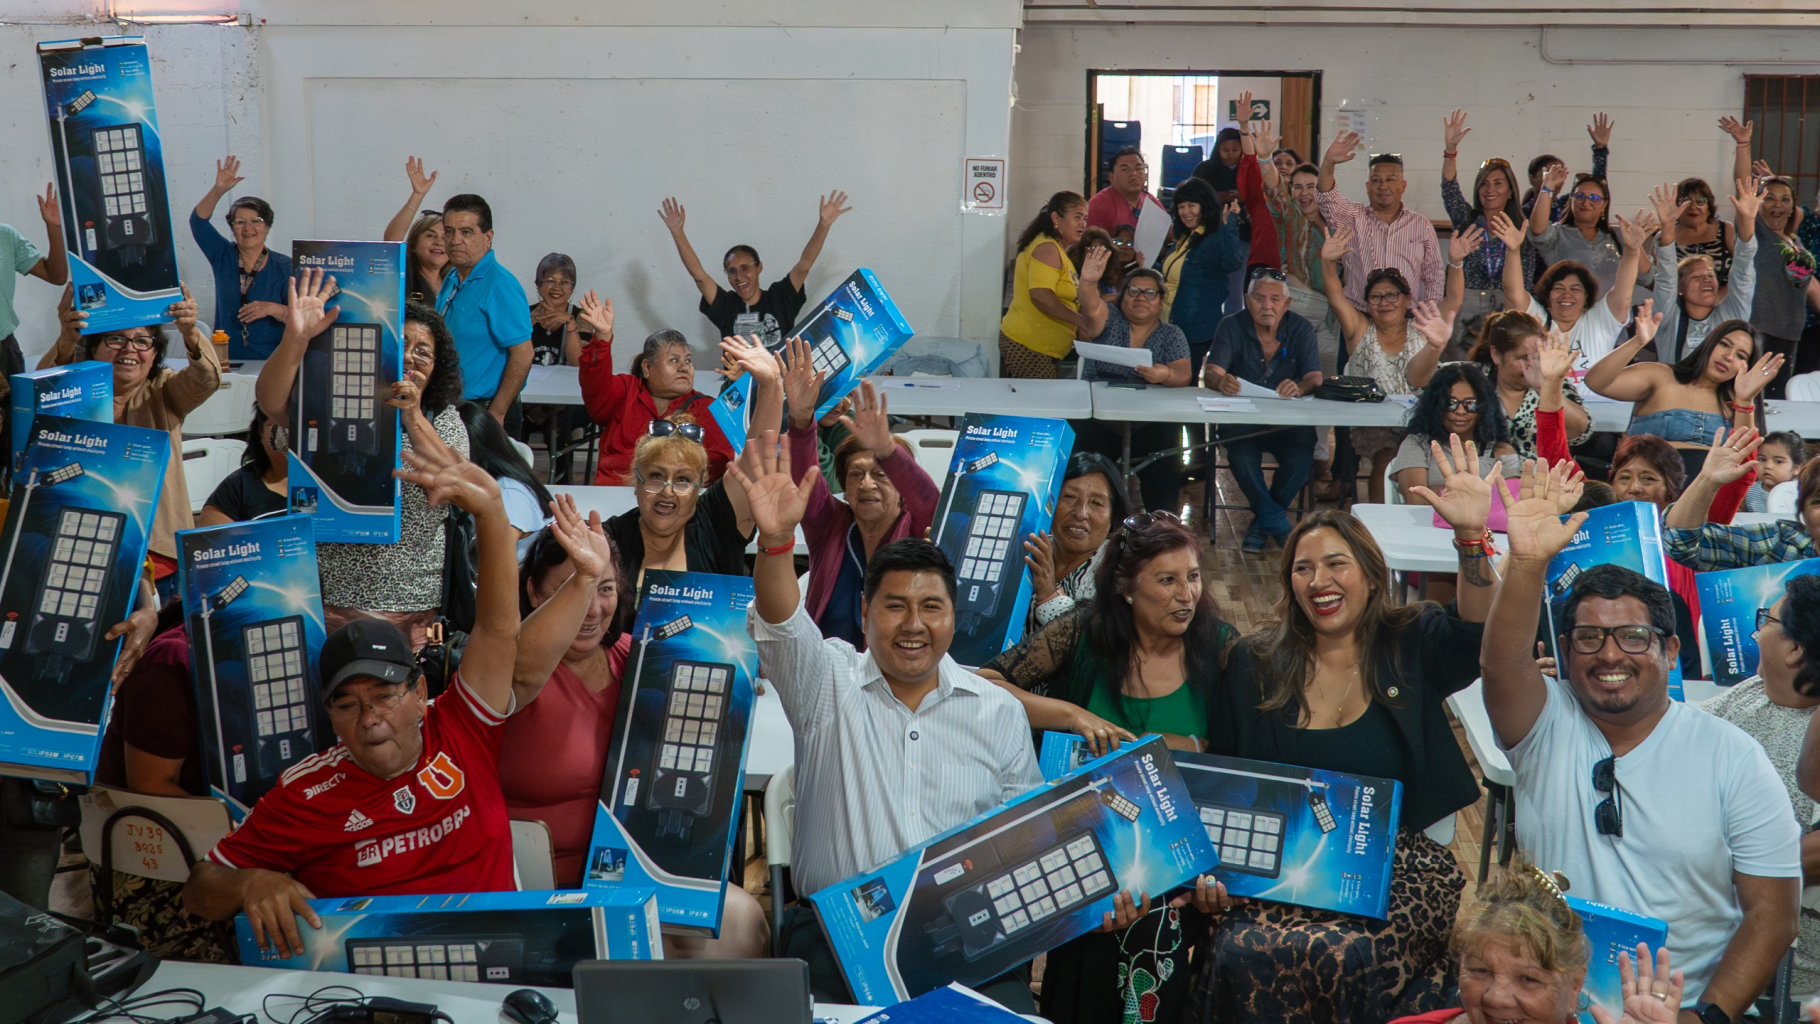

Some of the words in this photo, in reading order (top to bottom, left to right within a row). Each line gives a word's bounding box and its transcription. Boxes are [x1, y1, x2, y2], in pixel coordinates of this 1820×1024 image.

[50, 67, 76, 77] Solar
[78, 64, 105, 75] Light
[300, 255, 325, 264] Solar
[328, 256, 354, 267] Light
[849, 281, 862, 299] Solar
[860, 298, 875, 317] Light
[40, 391, 61, 402] Solar
[62, 386, 82, 398] Light
[39, 429, 72, 442] Solar
[74, 434, 108, 448] Light
[966, 425, 991, 436] Solar
[993, 427, 1017, 438] Light
[1570, 530, 1590, 544] ght
[193, 548, 226, 561] Solar
[228, 542, 261, 556] Light
[650, 584, 680, 596] Solar
[682, 587, 713, 600] Light
[1721, 618, 1733, 646] Light
[1727, 648, 1738, 674] Solar
[1141, 753, 1162, 787] Solar
[1156, 787, 1178, 822] Light
[1360, 786, 1375, 820] Solar
[1354, 821, 1371, 855] Light
[142, 856, 158, 870] 43
[686, 998, 698, 1010] hp
